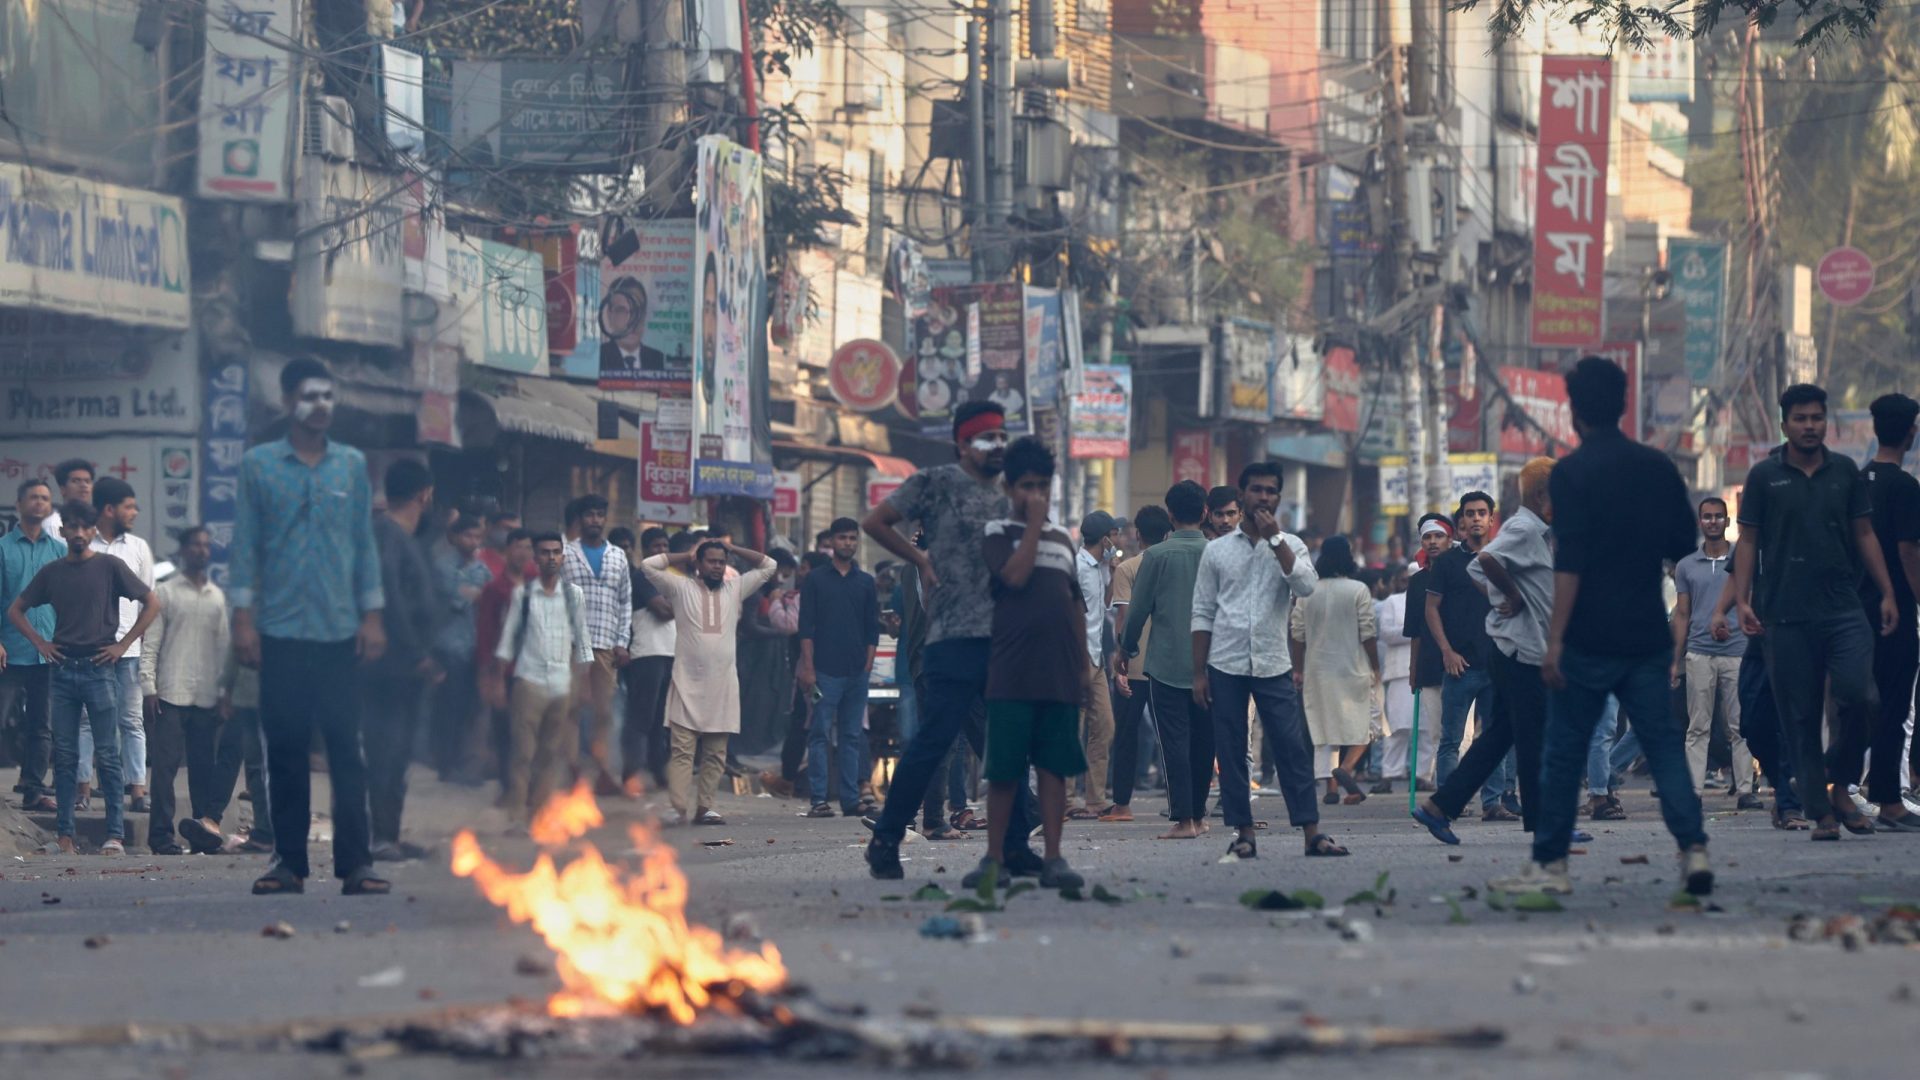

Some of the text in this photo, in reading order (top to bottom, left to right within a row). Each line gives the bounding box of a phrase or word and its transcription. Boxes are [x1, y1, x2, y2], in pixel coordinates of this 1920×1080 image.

[1545, 69, 1606, 289] শামীম
[81, 191, 161, 288] Limited
[8, 388, 121, 420] Pharma
